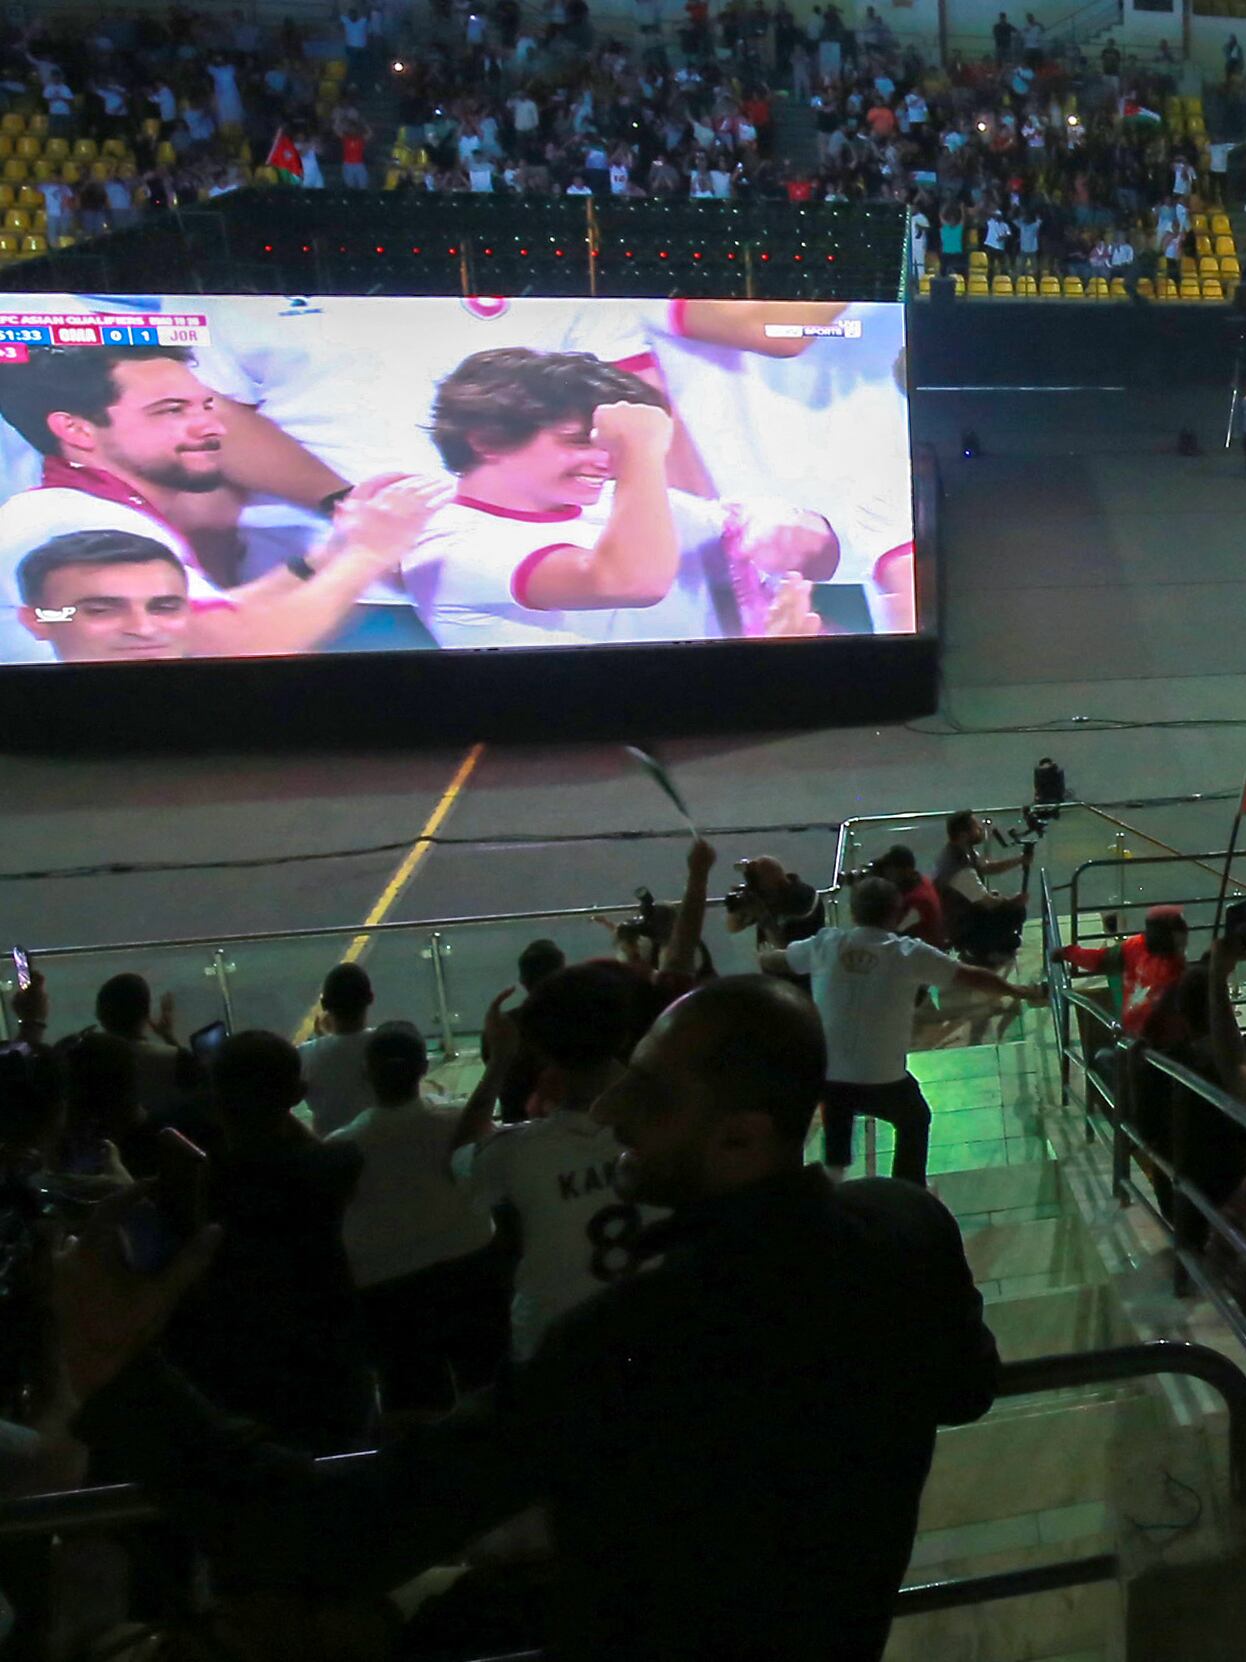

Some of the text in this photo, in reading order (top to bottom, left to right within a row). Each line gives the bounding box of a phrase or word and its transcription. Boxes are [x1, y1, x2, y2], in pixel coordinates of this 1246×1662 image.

[21, 316, 65, 325] ASIAN
[110, 330, 122, 341] 0
[141, 330, 150, 342] 1
[170, 329, 198, 342] JOR
